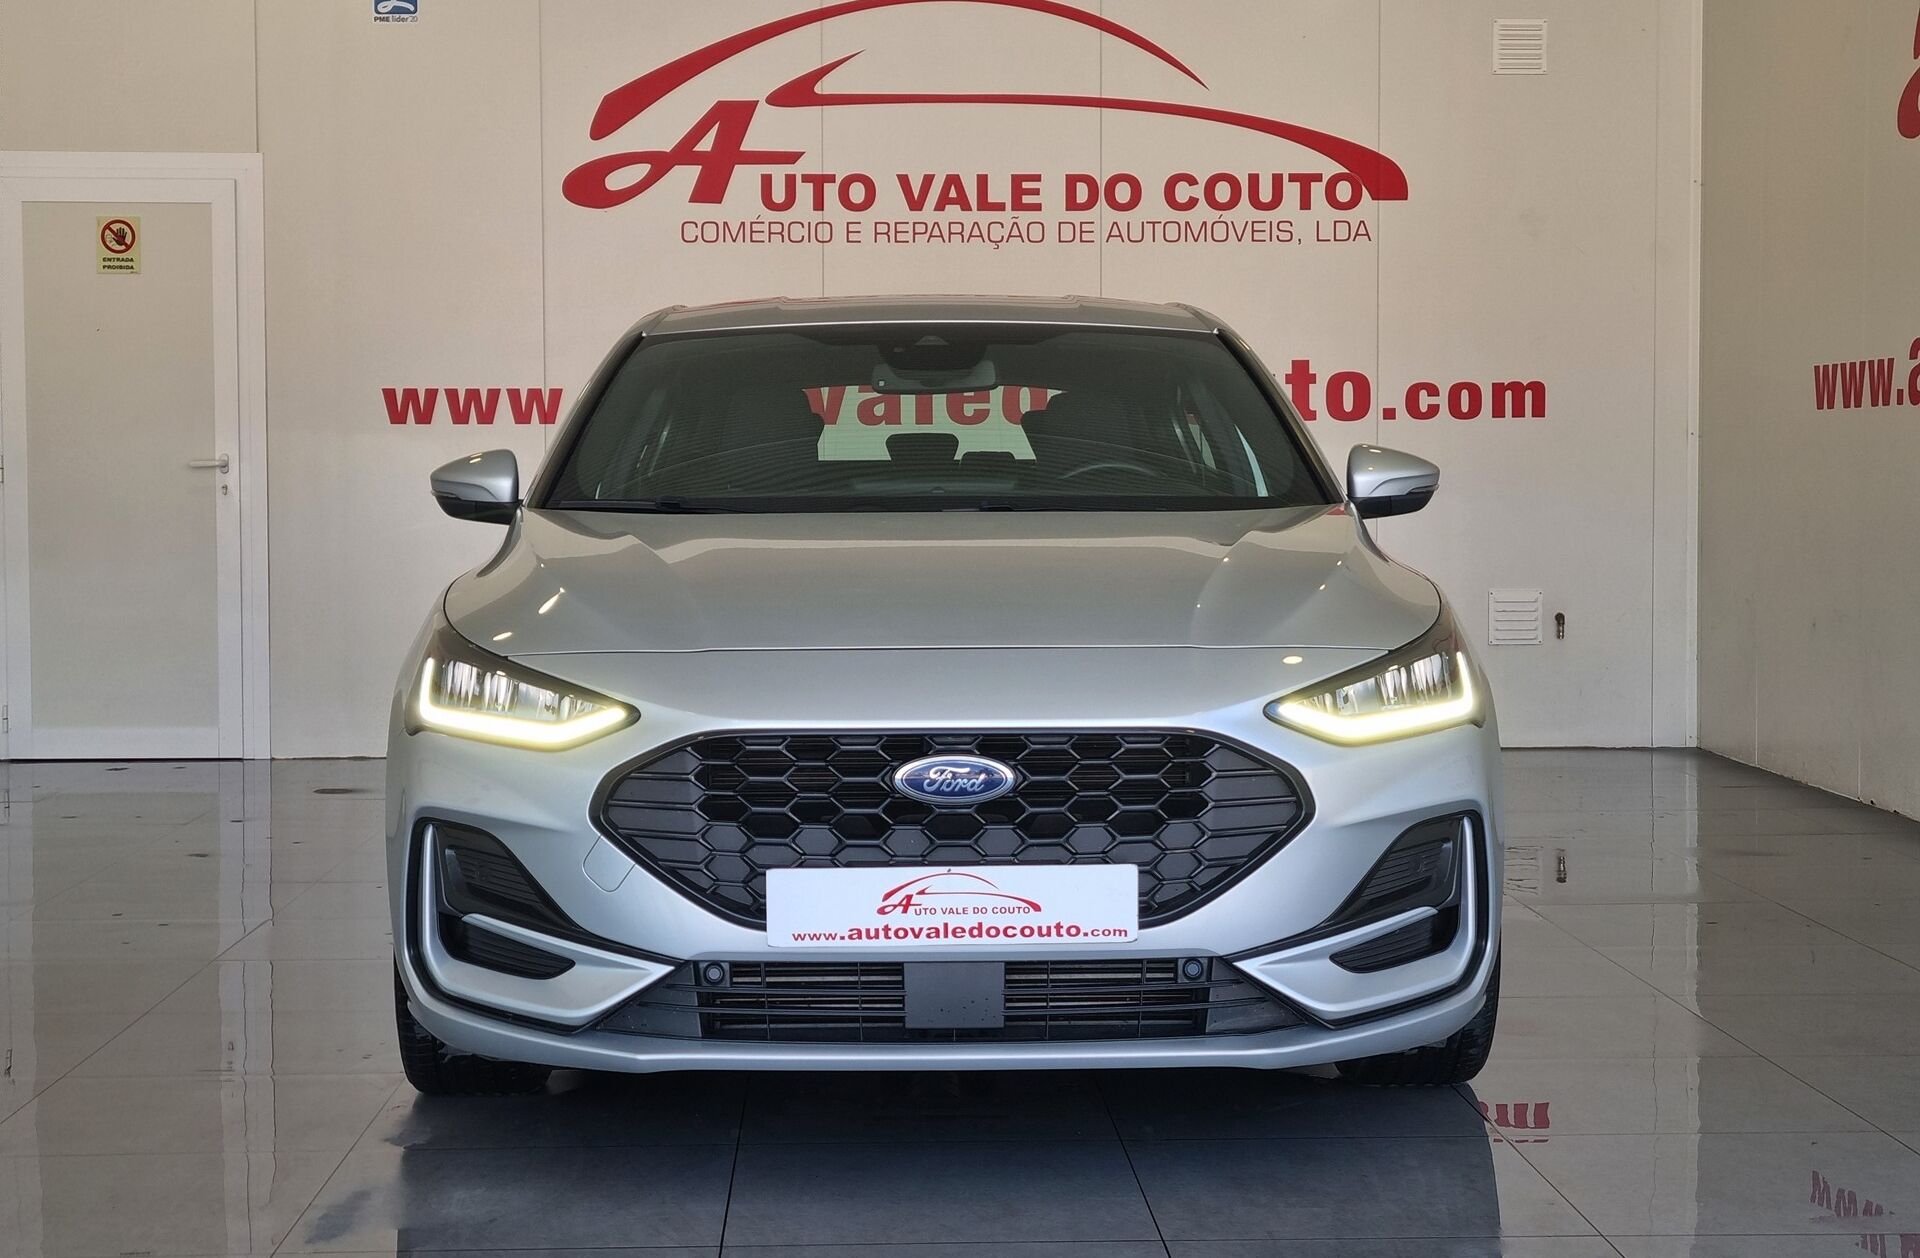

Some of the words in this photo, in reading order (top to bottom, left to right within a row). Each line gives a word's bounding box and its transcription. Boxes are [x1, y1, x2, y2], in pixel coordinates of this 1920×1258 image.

[562, 100, 877, 212] AUTO
[896, 173, 1042, 212] VALE
[1065, 172, 1143, 212] DO
[1163, 172, 1363, 212] COUTO
[680, 215, 834, 244] COMÉRCIO
[846, 221, 862, 243] E
[874, 216, 1045, 249] REPARAÇÃO
[1058, 221, 1095, 243] DE
[1106, 215, 1301, 245] AUTOMÓVEIS,
[1316, 221, 1372, 242] LDA
[923, 766, 985, 792] Ford
[877, 894, 937, 916] AUTO
[941, 907, 968, 915] VALE
[973, 906, 988, 915] DO
[992, 906, 1031, 915] COUTO
[792, 921, 1128, 941] www.autovaledocouto.com
